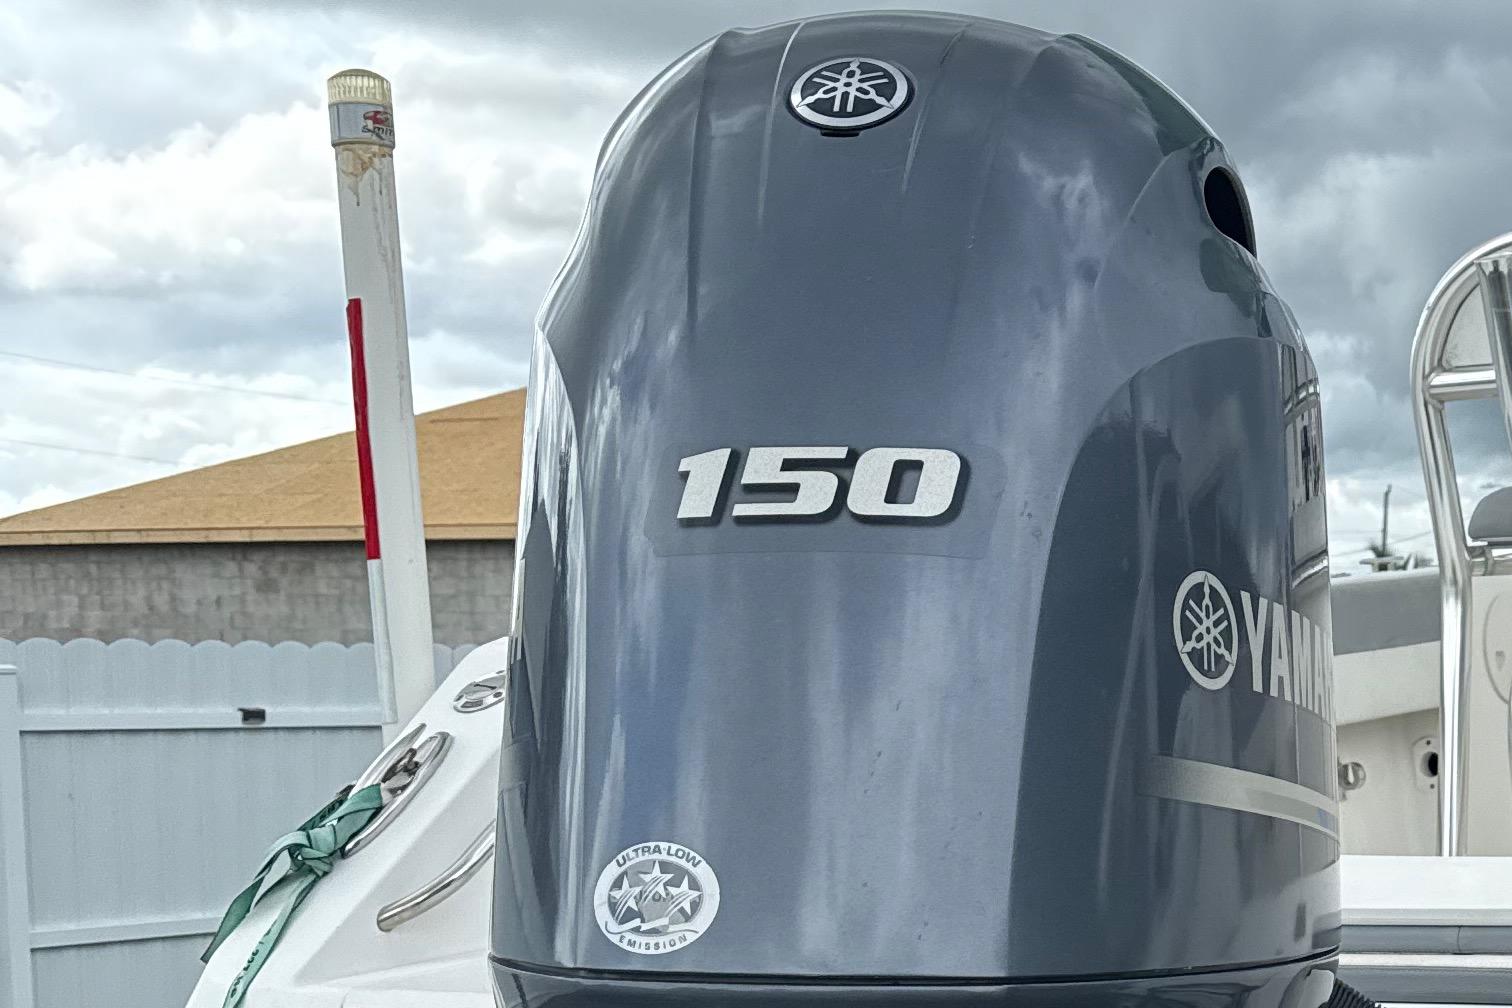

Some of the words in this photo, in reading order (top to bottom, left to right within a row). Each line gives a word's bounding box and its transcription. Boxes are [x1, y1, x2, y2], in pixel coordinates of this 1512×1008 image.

[676, 445, 963, 520] 150
[1240, 589, 1335, 724] YAMA
[666, 845, 702, 868] LOW
[618, 933, 687, 951] EMISSION
